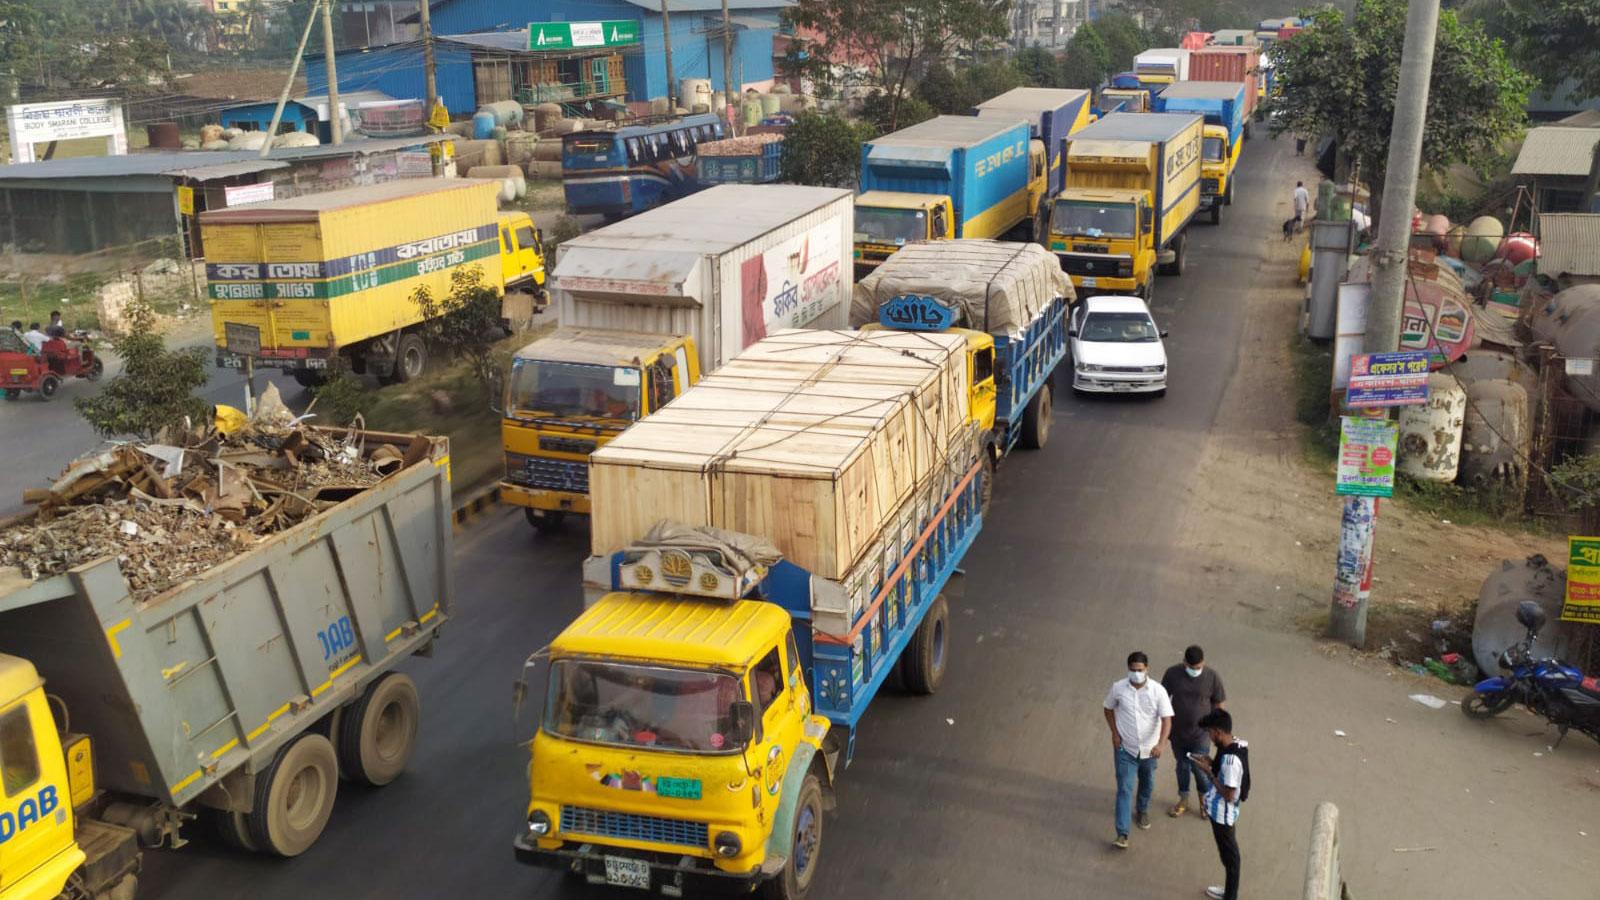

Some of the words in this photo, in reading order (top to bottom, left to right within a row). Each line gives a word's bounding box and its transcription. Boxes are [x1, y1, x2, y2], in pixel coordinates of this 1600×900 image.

[79, 116, 111, 125] COLLEGE
[214, 282, 264, 299] কুরিয়ার
[275, 281, 316, 297] সার্ভিস
[0, 784, 59, 845] DAB
